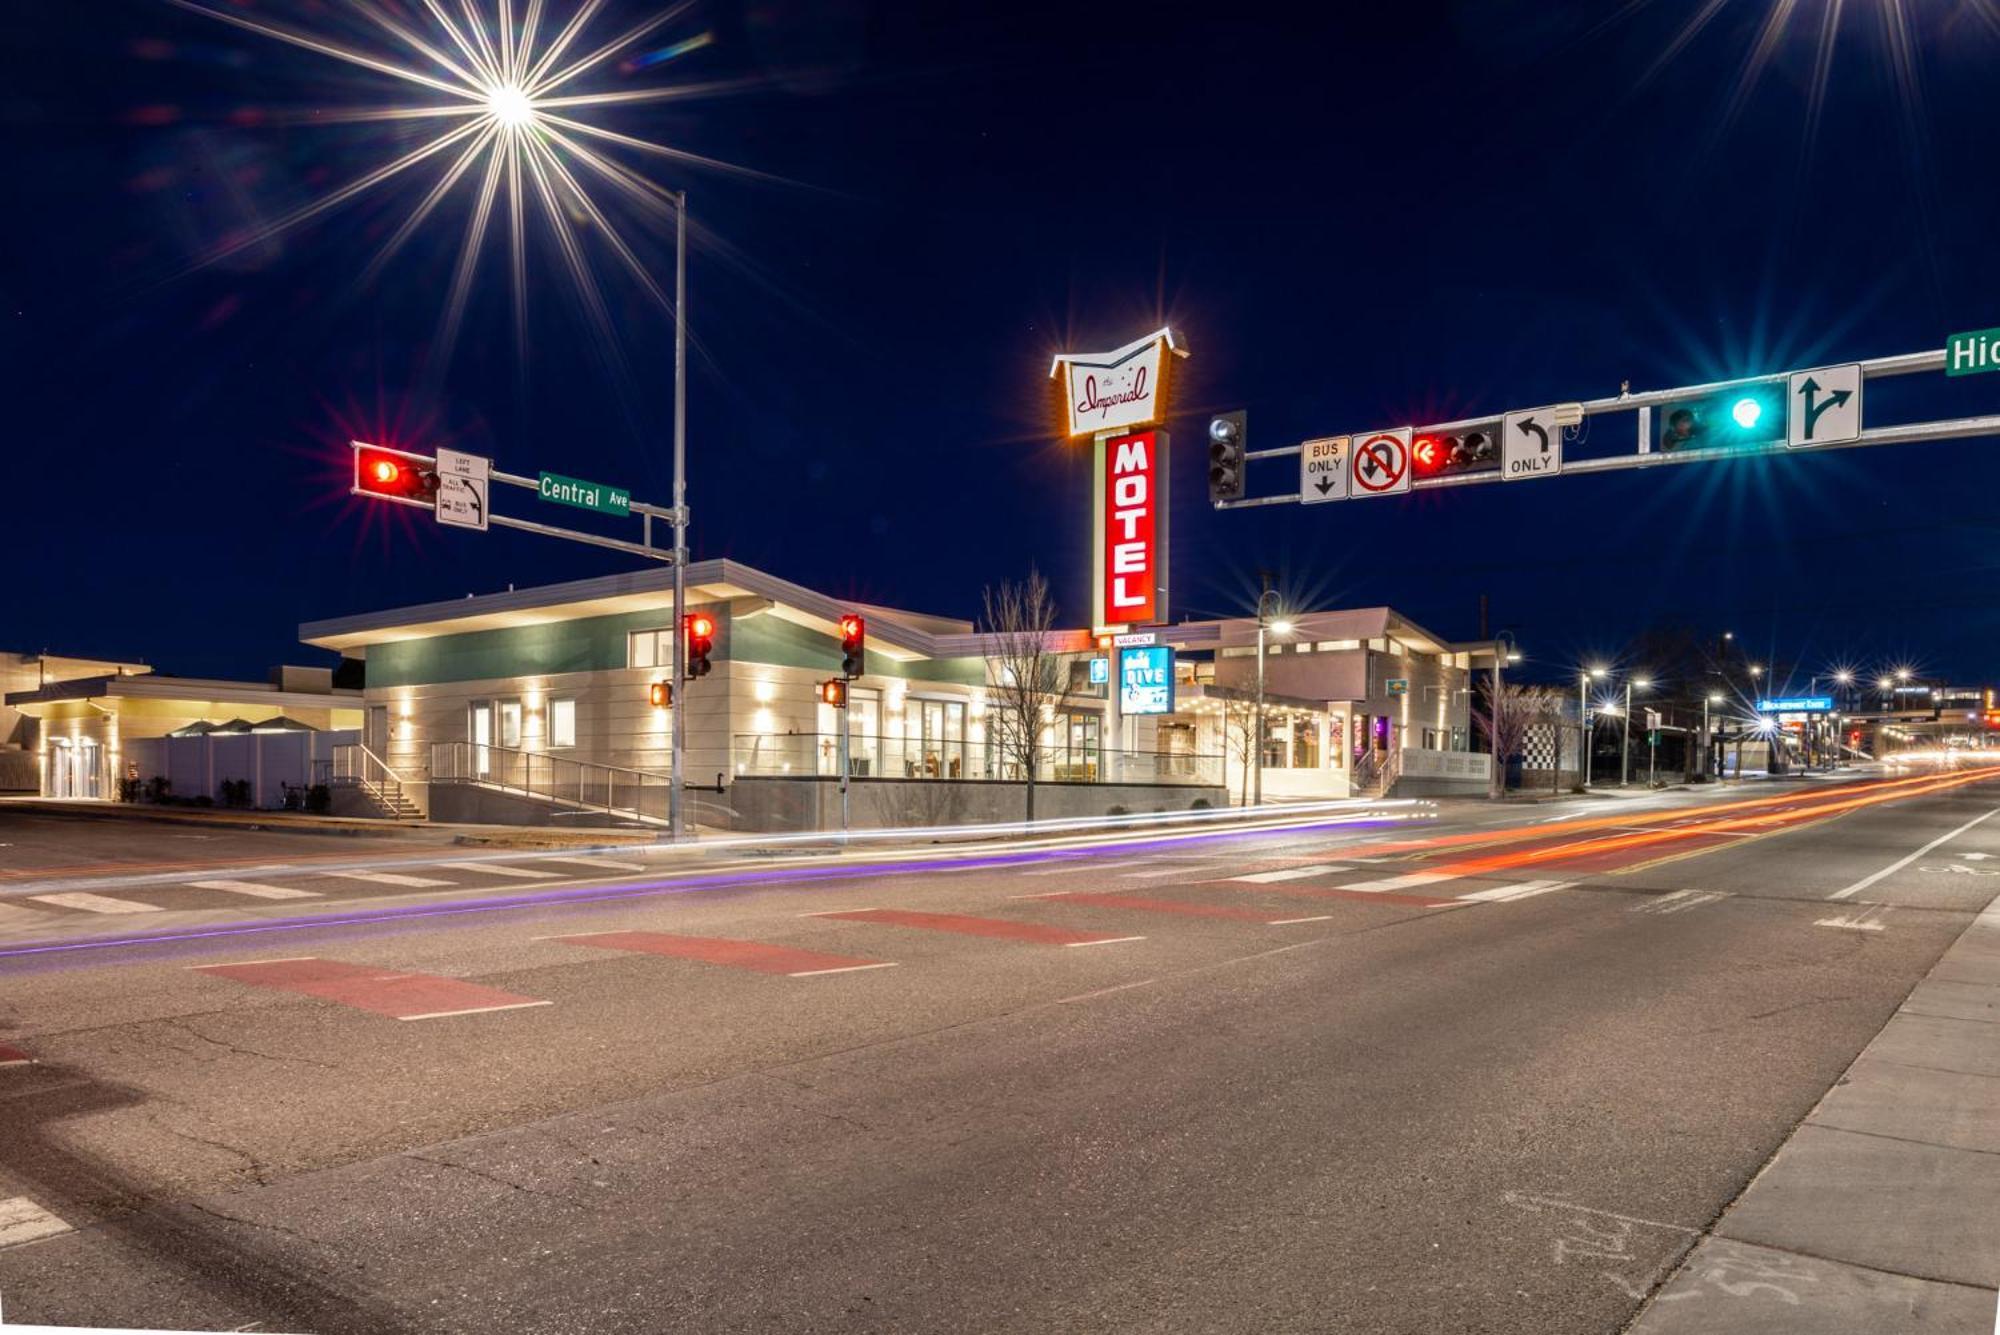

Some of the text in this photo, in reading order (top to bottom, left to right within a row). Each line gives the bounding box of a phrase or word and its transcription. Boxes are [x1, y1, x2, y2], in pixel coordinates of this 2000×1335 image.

[1077, 366, 1149, 419] Imperial
[1312, 444, 1338, 457] BUS
[1308, 459, 1341, 474] ONLY
[1511, 455, 1552, 472] ONLY
[541, 477, 628, 507] Central Ave
[1113, 440, 1148, 607] MOTEL
[1116, 635, 1152, 645] VACANCY
[1127, 668, 1165, 684] DIVE
